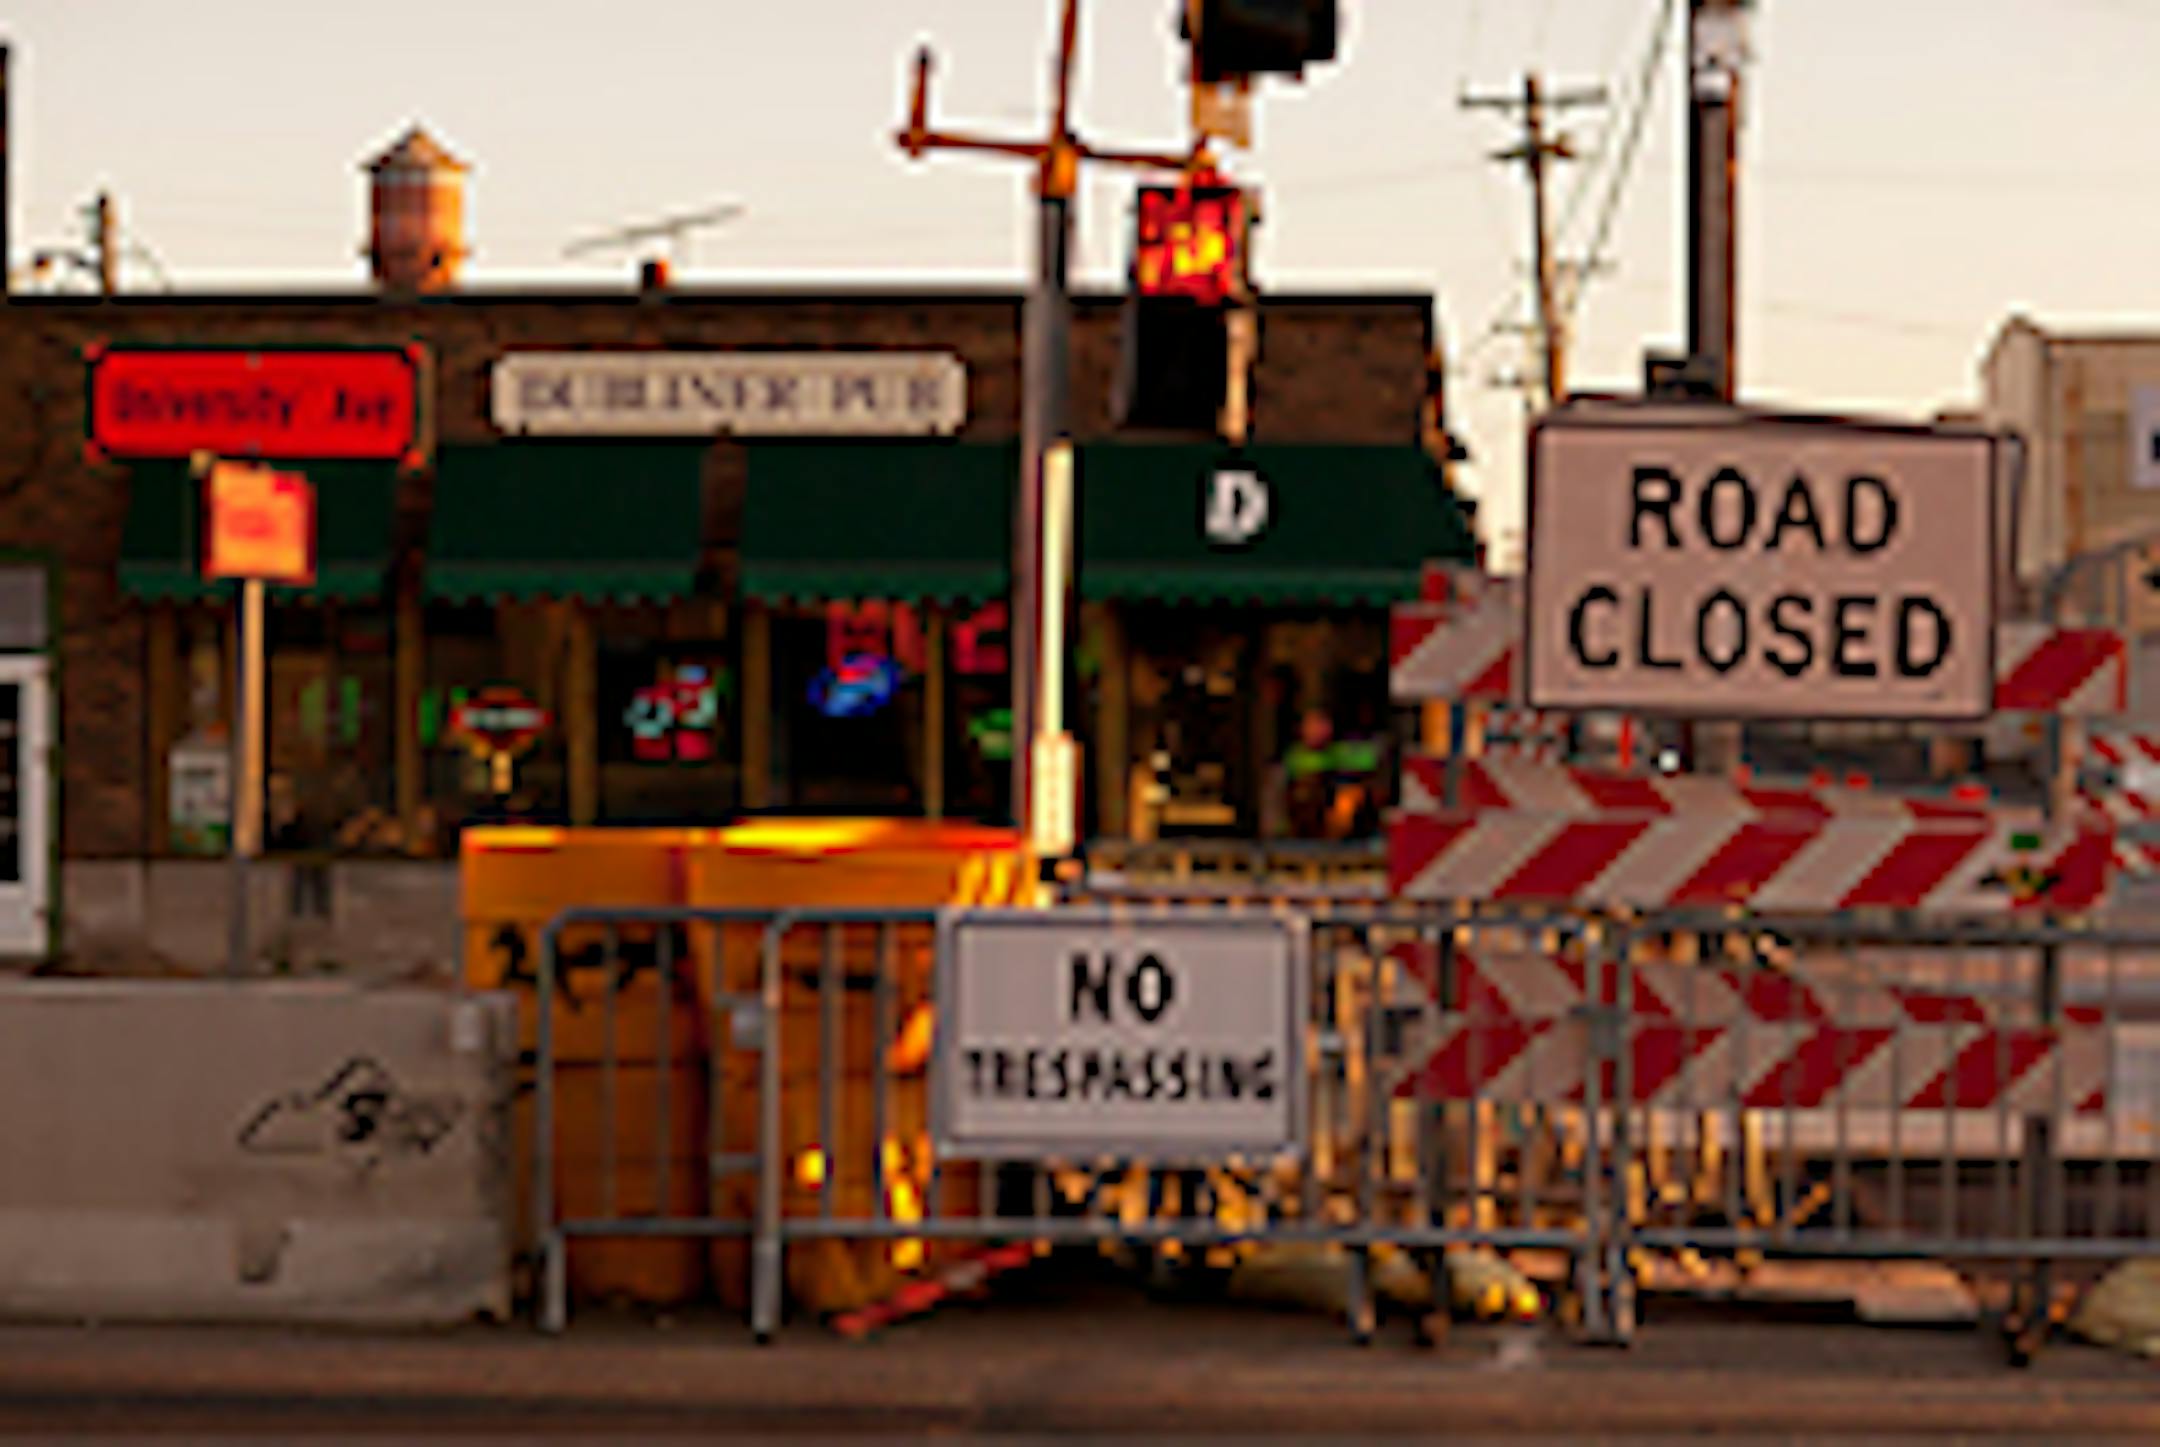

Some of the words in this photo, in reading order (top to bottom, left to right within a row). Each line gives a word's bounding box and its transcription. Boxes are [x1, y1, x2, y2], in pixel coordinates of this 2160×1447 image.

[1628, 466, 1898, 552] ROAD
[1568, 584, 1951, 677] CLOSED
[1070, 953, 1173, 1022] NO
[964, 1048, 1275, 1100] TRESPASSING
